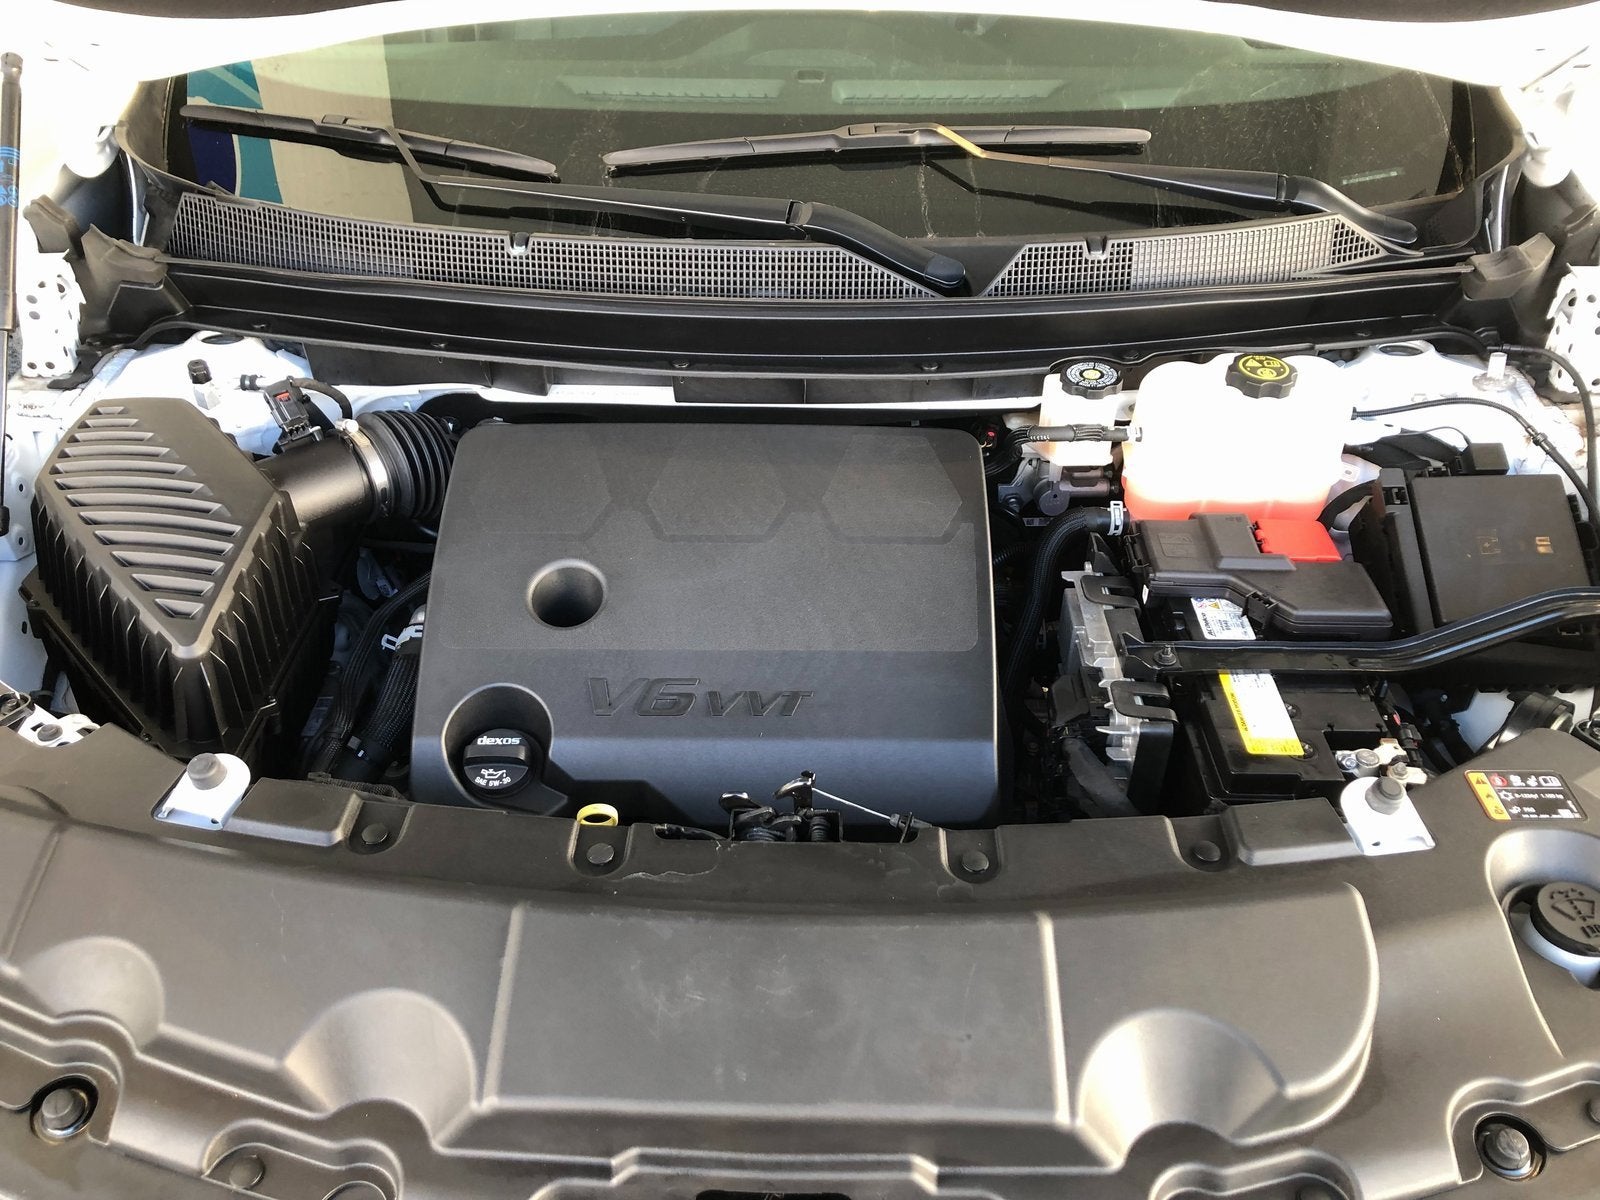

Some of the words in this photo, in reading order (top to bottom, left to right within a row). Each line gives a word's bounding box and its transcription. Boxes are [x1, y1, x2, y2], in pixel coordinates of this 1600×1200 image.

[587, 677, 701, 717] V6
[706, 690, 814, 717] VVT
[476, 735, 522, 746] dexos
[474, 776, 488, 786] SAE
[488, 776, 512, 787] 5W-30
